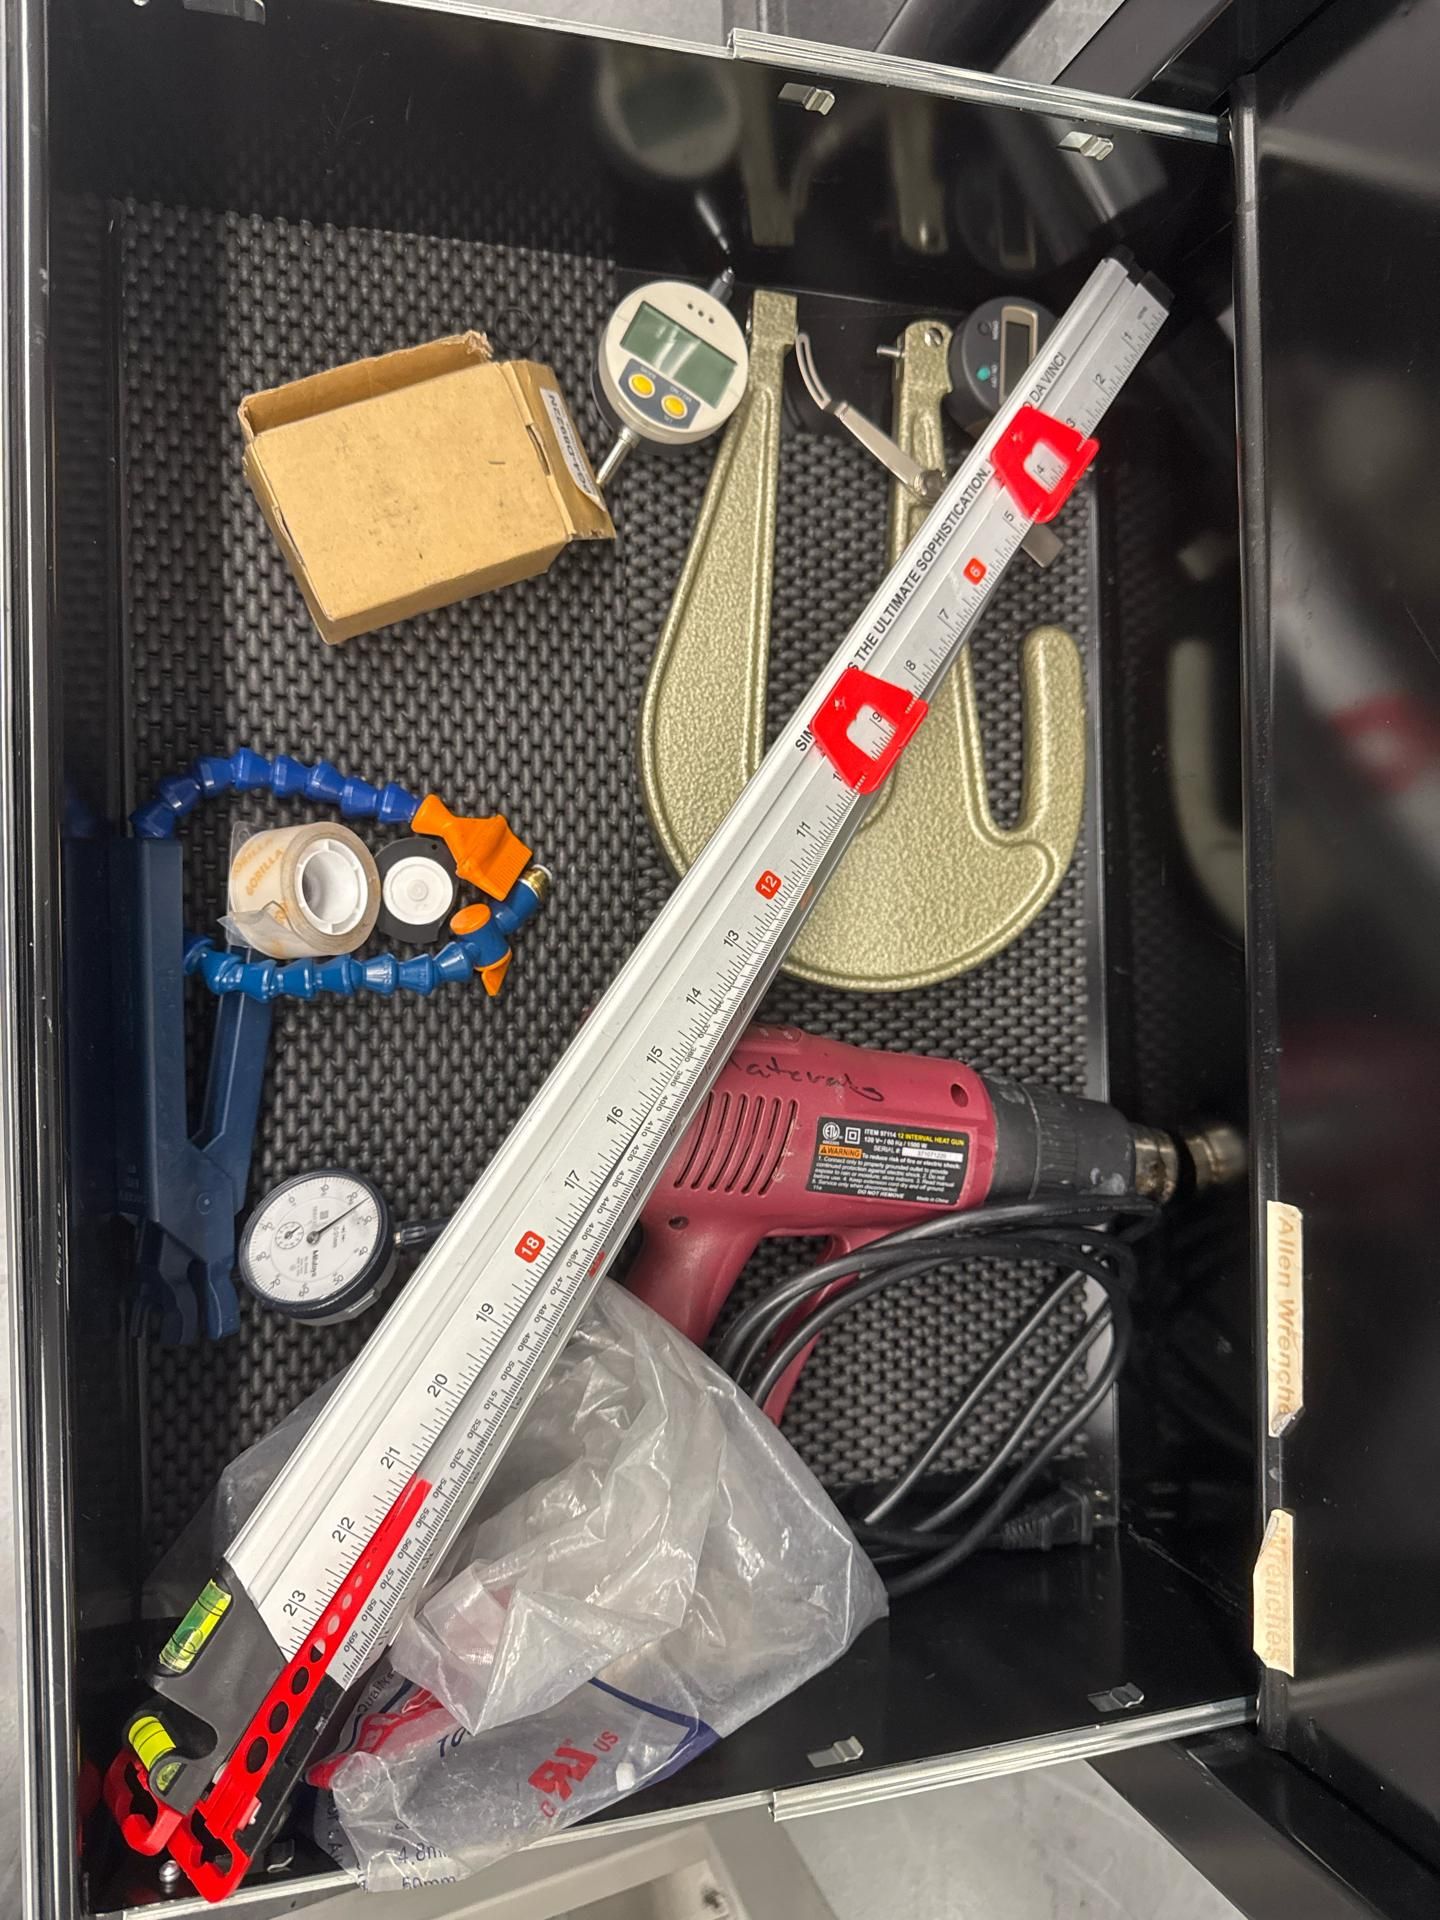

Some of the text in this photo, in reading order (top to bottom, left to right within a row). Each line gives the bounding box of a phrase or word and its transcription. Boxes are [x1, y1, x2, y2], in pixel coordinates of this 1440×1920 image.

[1124, 331, 1132, 341] 1
[1029, 352, 1067, 402] DA VINCI
[1095, 374, 1105, 385] 2
[1066, 418, 1076, 428] 3
[1036, 464, 1045, 473] 4
[1004, 511, 1015, 523] 5
[854, 467, 991, 662] THE ULTIMATE SOPHISTICATION.
[970, 567, 979, 577] 6
[940, 608, 950, 620] 7
[906, 659, 917, 671] 8
[871, 711, 882, 722] 9
[796, 821, 811, 837] 11
[760, 875, 777, 893] 12
[723, 929, 740, 948] 13
[686, 987, 702, 1005] 14
[646, 1045, 663, 1064] 15
[671, 1071, 683, 1086] 390
[656, 1094, 669, 1111] 400
[606, 1106, 624, 1125] 16
[642, 1120, 653, 1136] 410
[873, 1145, 894, 1153] SERIAL
[905, 1133, 933, 1142] INTERVAL
[934, 1136, 950, 1144] HEAT
[951, 1138, 965, 1146] GUN
[627, 1145, 639, 1161] 420
[828, 1147, 860, 1157] WARNING
[564, 1170, 582, 1190] 17
[612, 1170, 625, 1187] 430
[880, 1190, 904, 1199] REMOVE
[597, 1196, 609, 1213] 440
[581, 1222, 594, 1240] 450
[521, 1235, 539, 1257] 18
[1278, 1215, 1295, 1288] Allen
[566, 1249, 578, 1267] 460
[550, 1276, 563, 1295] 470
[475, 1303, 495, 1325] 19
[533, 1303, 548, 1323] 480
[517, 1332, 531, 1351] 490
[500, 1360, 515, 1380] 500
[427, 1372, 449, 1397] 20
[484, 1390, 498, 1410] 510
[467, 1419, 481, 1439] 520
[380, 1446, 400, 1470] 21
[450, 1448, 464, 1469] 530
[433, 1478, 447, 1498] 540
[416, 1508, 430, 1527] 550
[332, 1516, 355, 1543] 22
[398, 1538, 412, 1559] 560
[380, 1568, 395, 1590] 570
[283, 1589, 307, 1617] 23
[361, 1598, 377, 1622] 580
[344, 1631, 358, 1653] 590
[593, 1731, 618, 1752] US
